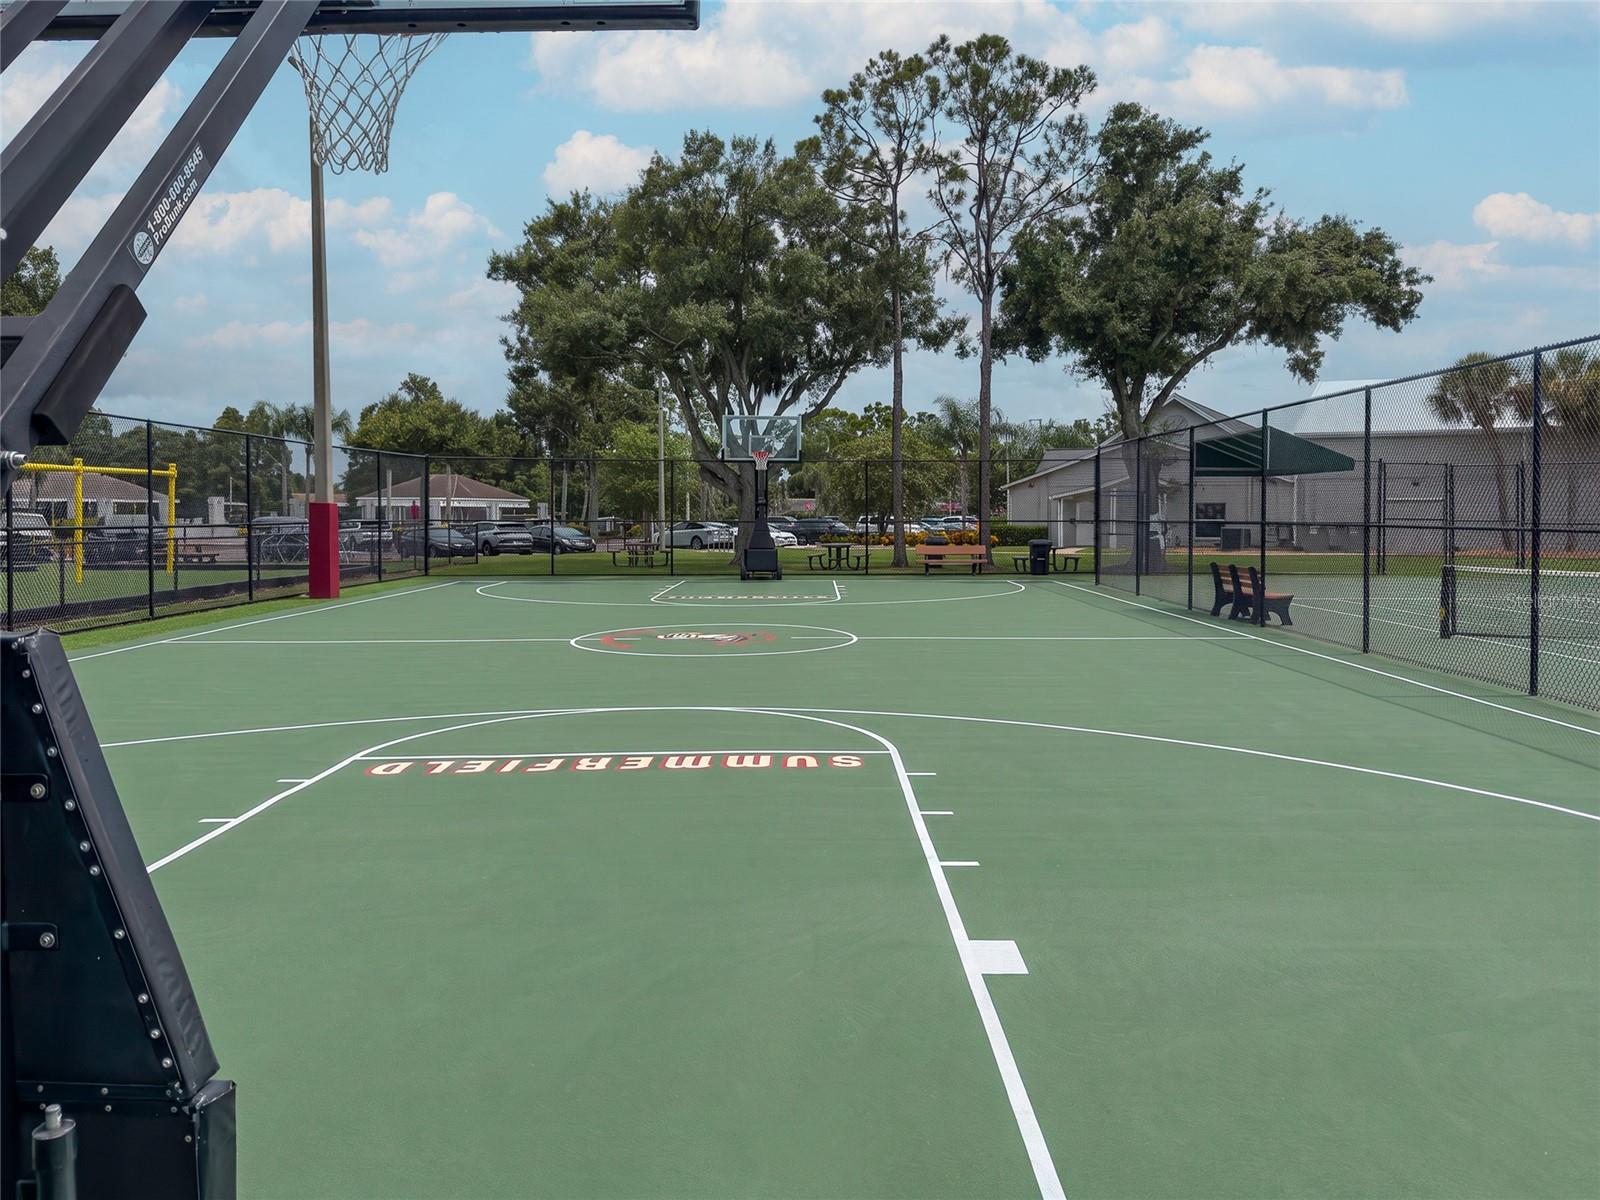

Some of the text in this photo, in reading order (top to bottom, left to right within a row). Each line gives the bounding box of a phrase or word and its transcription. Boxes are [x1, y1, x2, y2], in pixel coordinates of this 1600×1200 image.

[147, 147, 204, 233] 1-800-600-8545
[153, 178, 198, 245] ProDunk.com
[364, 754, 864, 776] SUMMERFIELD
